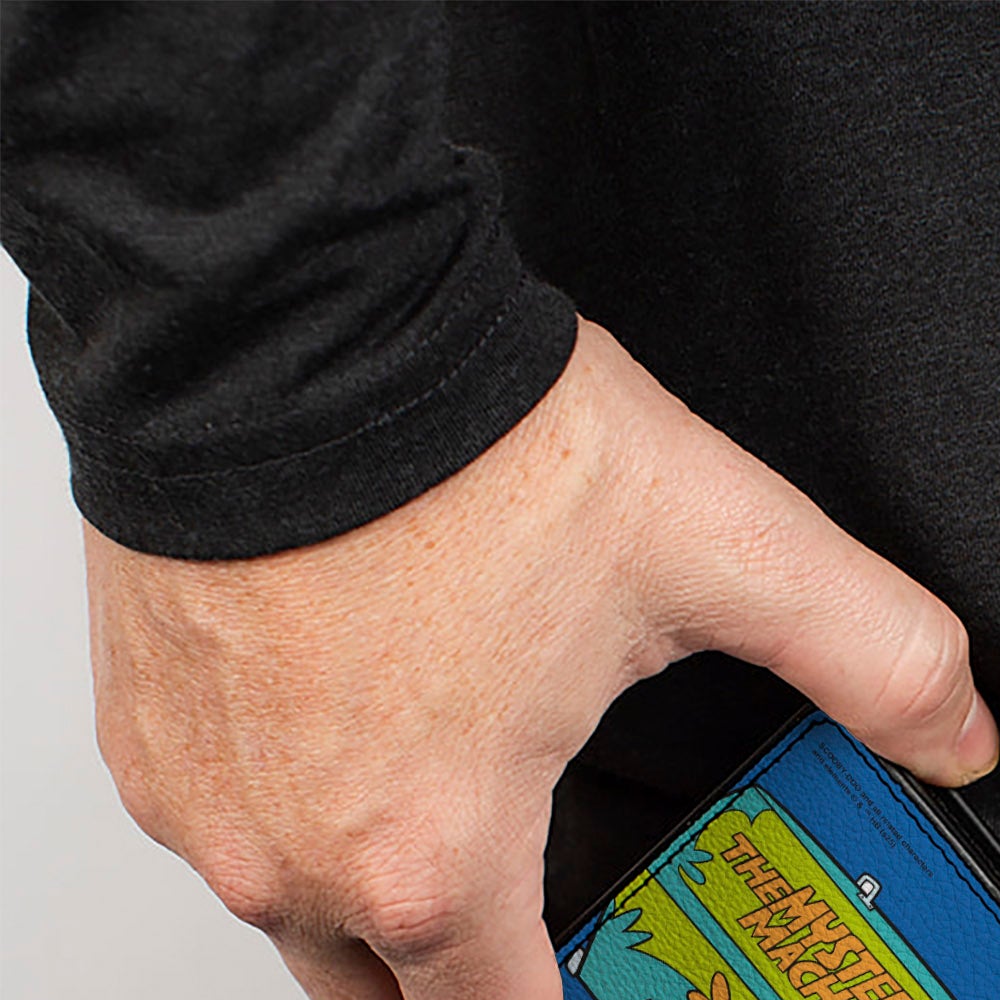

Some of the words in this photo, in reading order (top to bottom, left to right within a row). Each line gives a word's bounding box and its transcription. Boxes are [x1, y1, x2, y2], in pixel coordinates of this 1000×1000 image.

[811, 749, 825, 765] and
[823, 763, 851, 795] elements
[818, 742, 861, 792] SCOOBY-DOO
[860, 792, 874, 807] and
[872, 805, 882, 815] all
[880, 816, 903, 840] related
[901, 840, 934, 878] characters
[720, 831, 794, 906] THE
